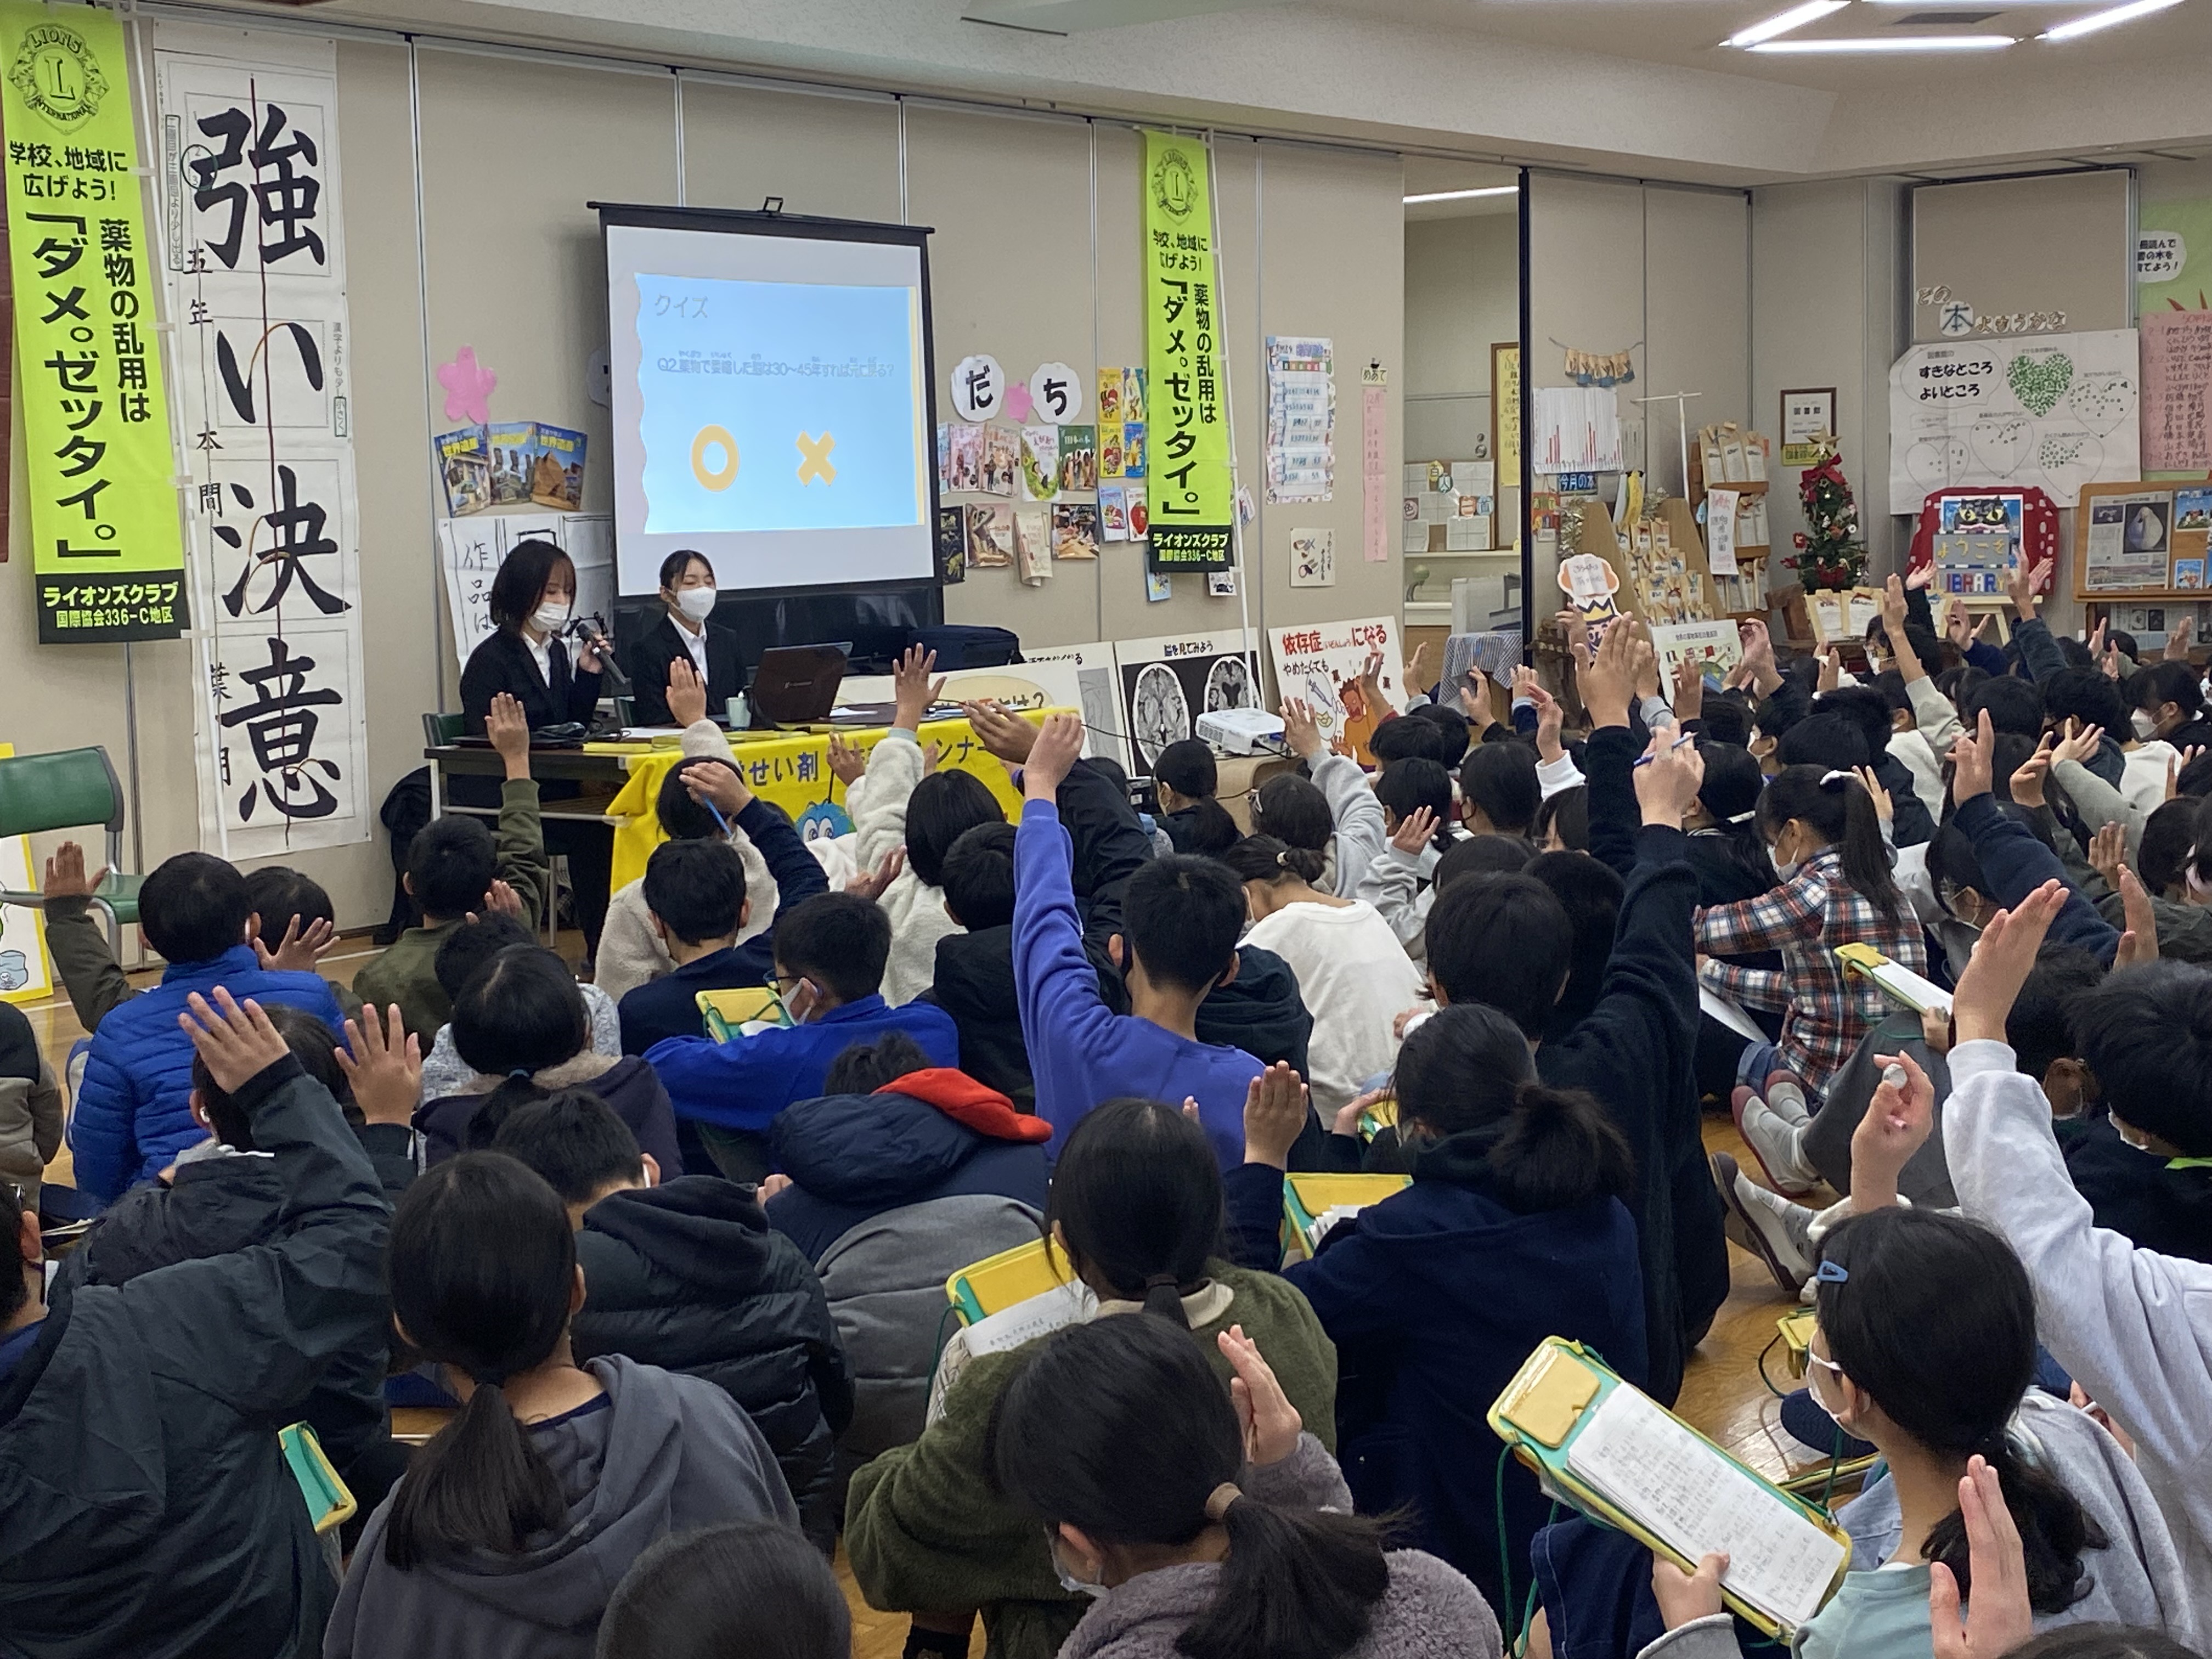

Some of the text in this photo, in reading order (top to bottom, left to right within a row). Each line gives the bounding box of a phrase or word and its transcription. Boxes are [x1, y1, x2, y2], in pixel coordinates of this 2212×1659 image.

[30, 29, 82, 54] LIONS
[44, 55, 76, 100] L
[10, 140, 128, 174] 学校、地域に
[23, 174, 116, 201] 広げよう！
[654, 294, 709, 319] クイズ
[99, 218, 152, 423] 薬物の乱用は
[1193, 283, 1217, 424] 薬物の乱用は
[1363, 369, 1387, 382] めあて
[1919, 360, 1994, 379] すきなところ
[966, 364, 1068, 416] だ ち
[1920, 383, 1980, 400] よいところ
[1152, 532, 1229, 549] ライオンズクラブ
[1937, 537, 2005, 560] ようこそ
[43, 581, 179, 607] ライオンズクラブ
[1282, 630, 1323, 656] 依存症
[1351, 624, 1387, 647] になる
[1283, 658, 1330, 676] やめたくても
